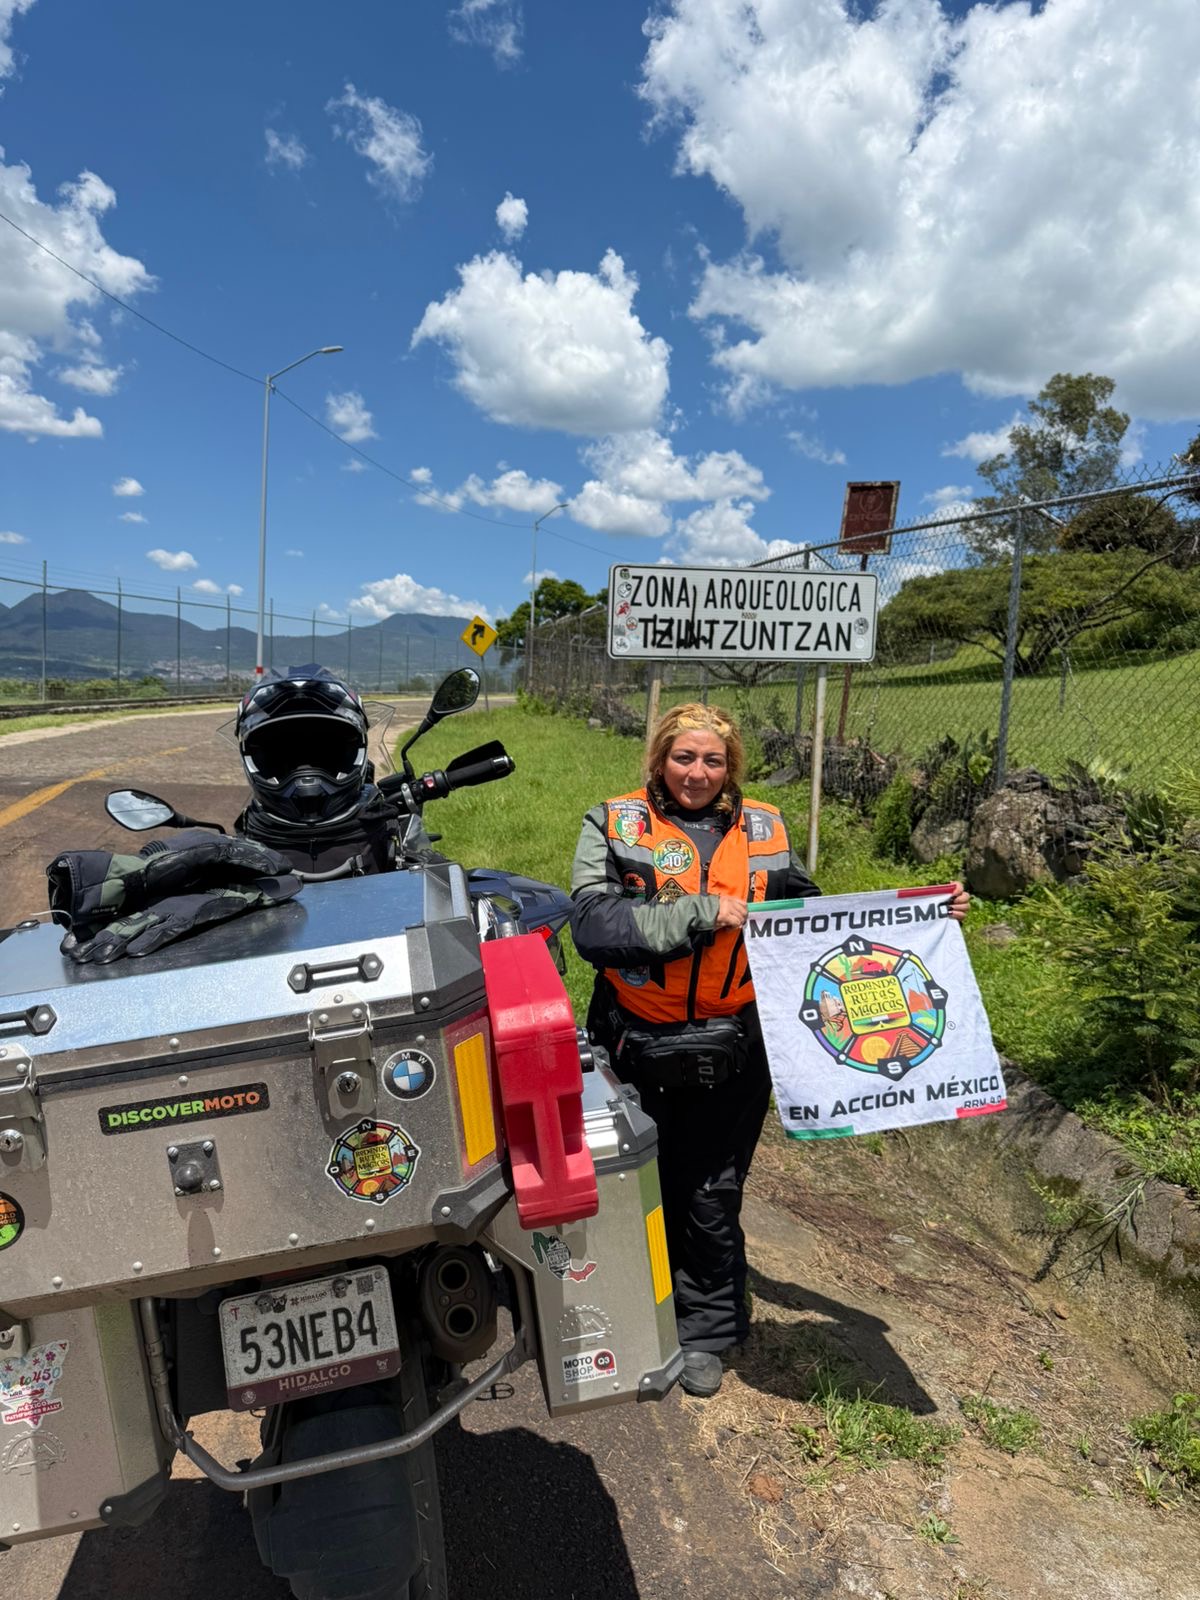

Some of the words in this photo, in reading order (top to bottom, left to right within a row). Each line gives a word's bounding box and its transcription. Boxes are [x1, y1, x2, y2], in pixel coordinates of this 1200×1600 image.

[630, 575, 691, 609] ZONA
[704, 578, 862, 613] ARQUEOLOGICA
[668, 854, 682, 867] 10
[750, 903, 951, 938] MOTOTURISMO
[849, 940, 865, 952] N
[930, 988, 945, 1000] E
[803, 1008, 818, 1021] O
[388, 1052, 428, 1070] BMW
[887, 1061, 903, 1074] S
[789, 1104, 819, 1120] EN
[830, 1085, 915, 1117] ACCIÓN
[926, 1075, 1000, 1101] MÉXICO
[107, 1091, 260, 1128] DISCOVERMOTO
[361, 1122, 372, 1131] N
[240, 1300, 378, 1374] 53NEB4
[563, 1356, 593, 1369] MOTO
[279, 1364, 352, 1391] HIDALGO
[565, 1366, 594, 1379] SHOP
[42, 1403, 61, 1413] RALLY
